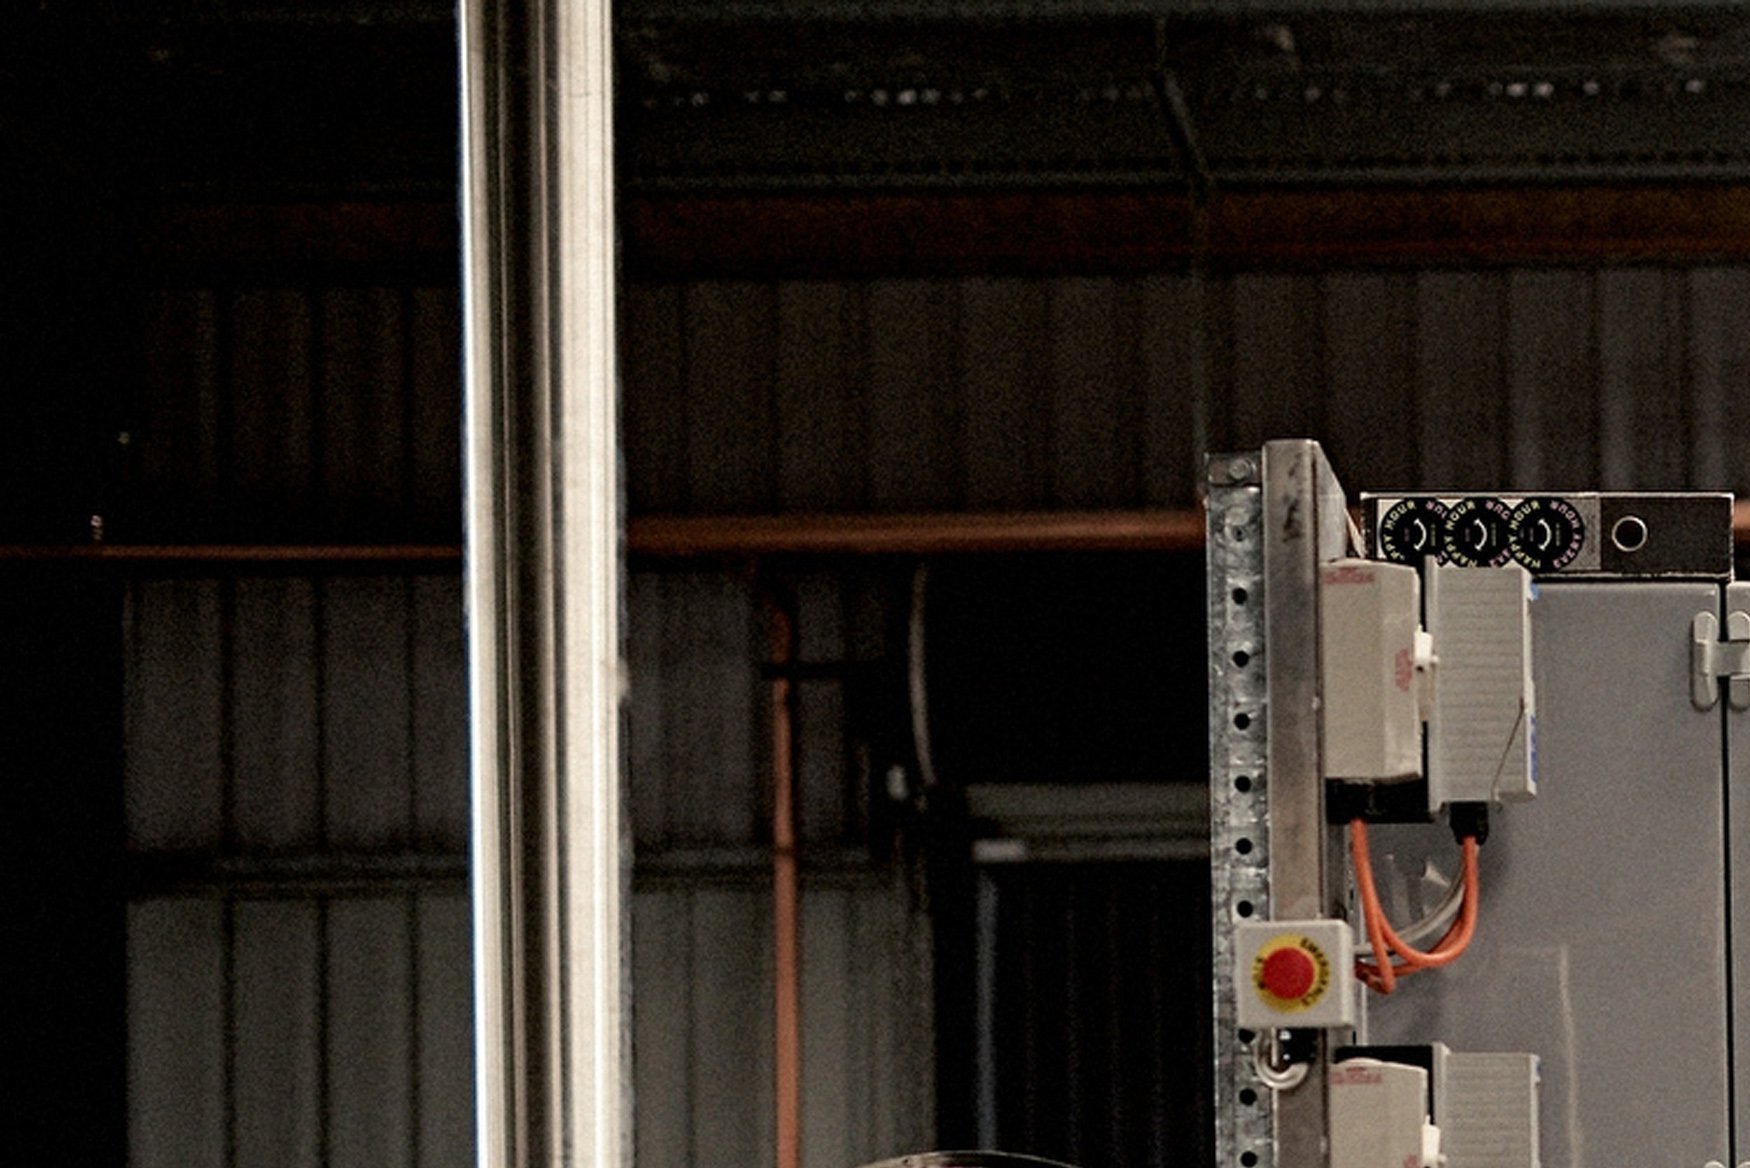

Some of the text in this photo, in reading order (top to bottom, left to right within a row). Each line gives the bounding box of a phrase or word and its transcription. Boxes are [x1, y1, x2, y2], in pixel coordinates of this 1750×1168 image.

[1384, 500, 1416, 530] HOUR
[1444, 500, 1475, 531] HOUR
[1550, 500, 1580, 529] HOUR
[1507, 500, 1541, 569] HAPPY HOUR
